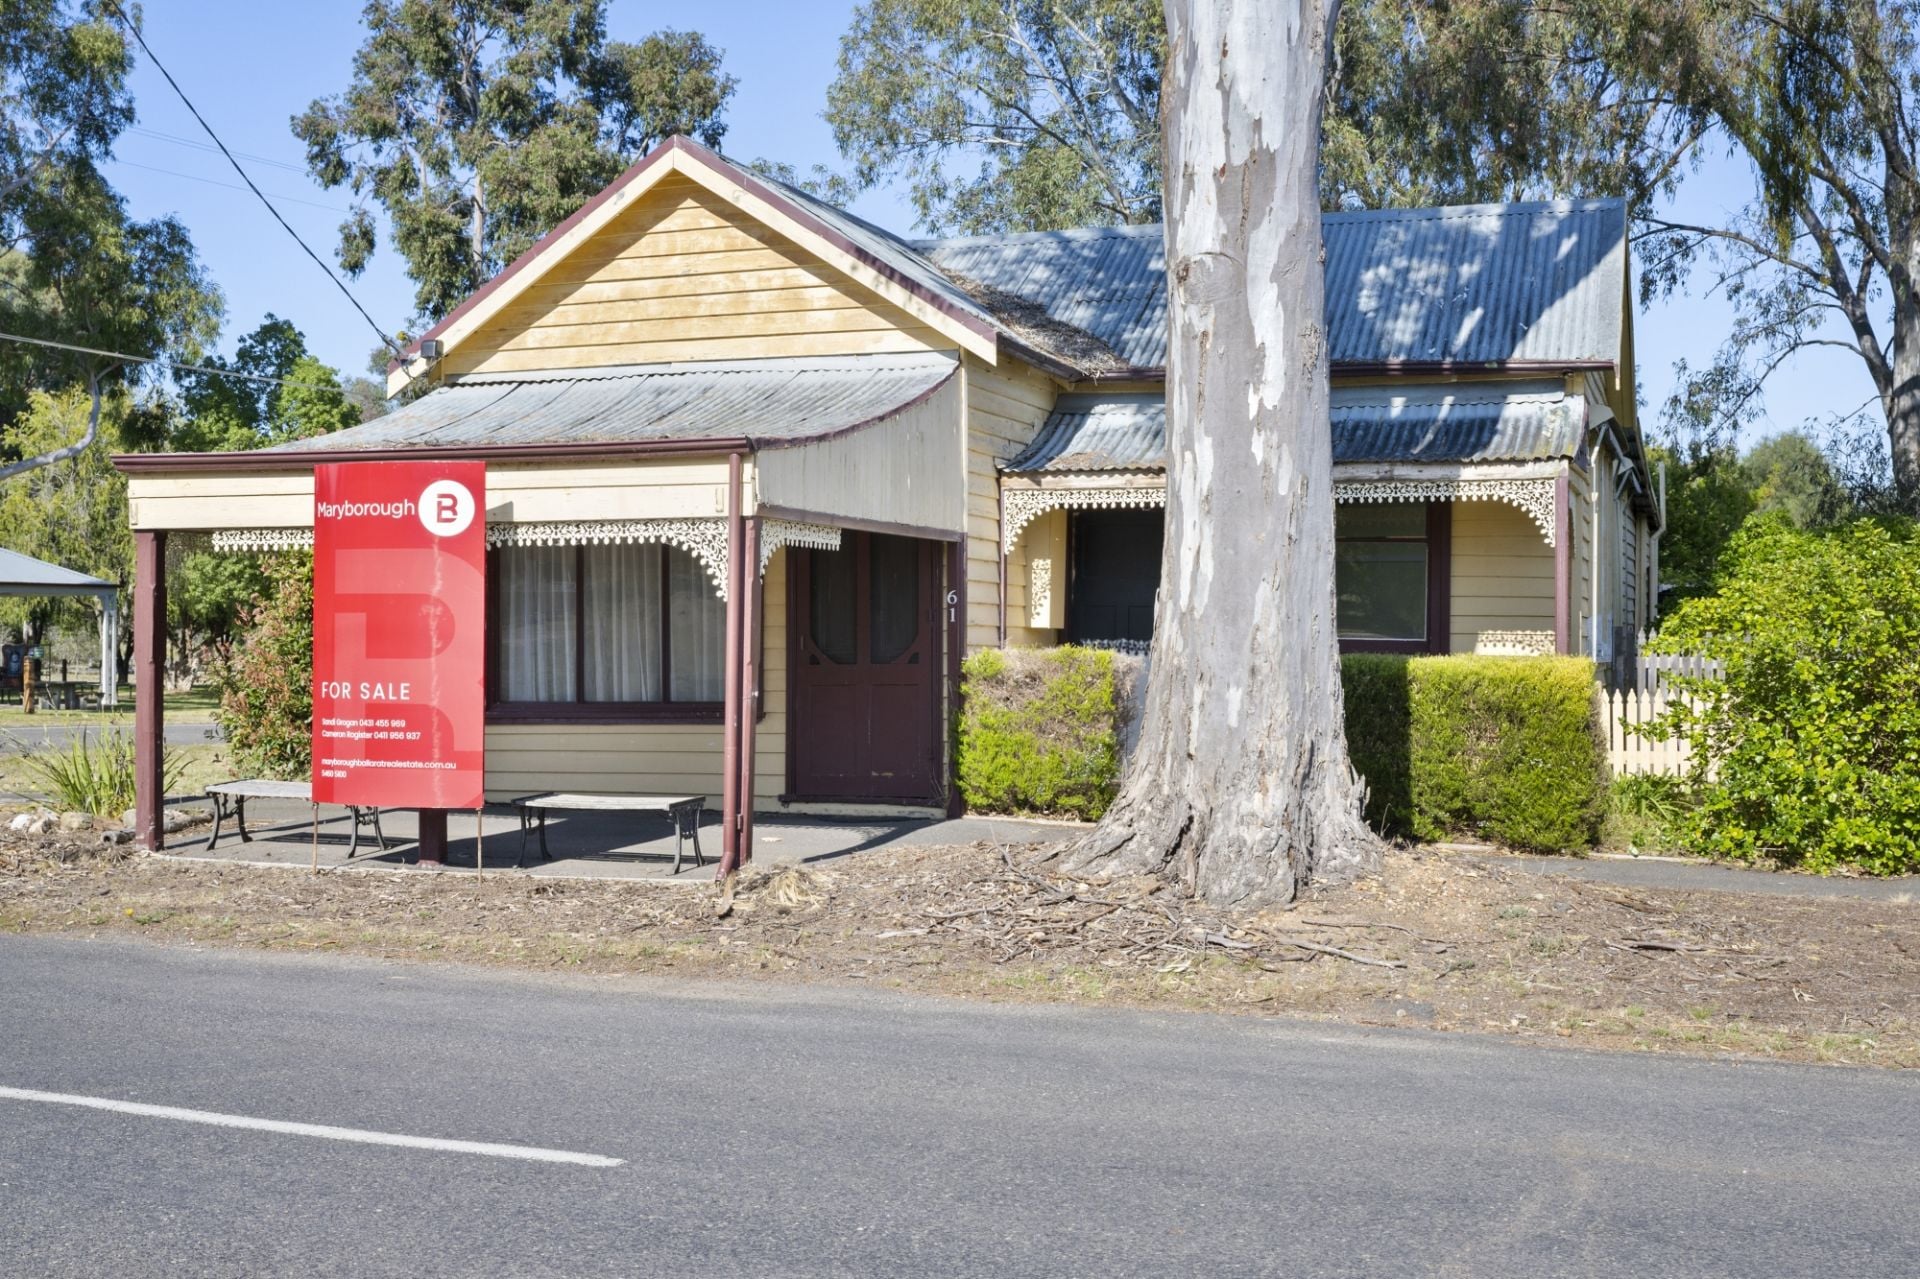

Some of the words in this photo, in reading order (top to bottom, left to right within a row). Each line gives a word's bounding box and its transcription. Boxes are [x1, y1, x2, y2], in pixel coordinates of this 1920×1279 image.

[317, 499, 415, 519] Maryborough
[321, 681, 351, 699] FOR
[360, 682, 410, 700] SALE
